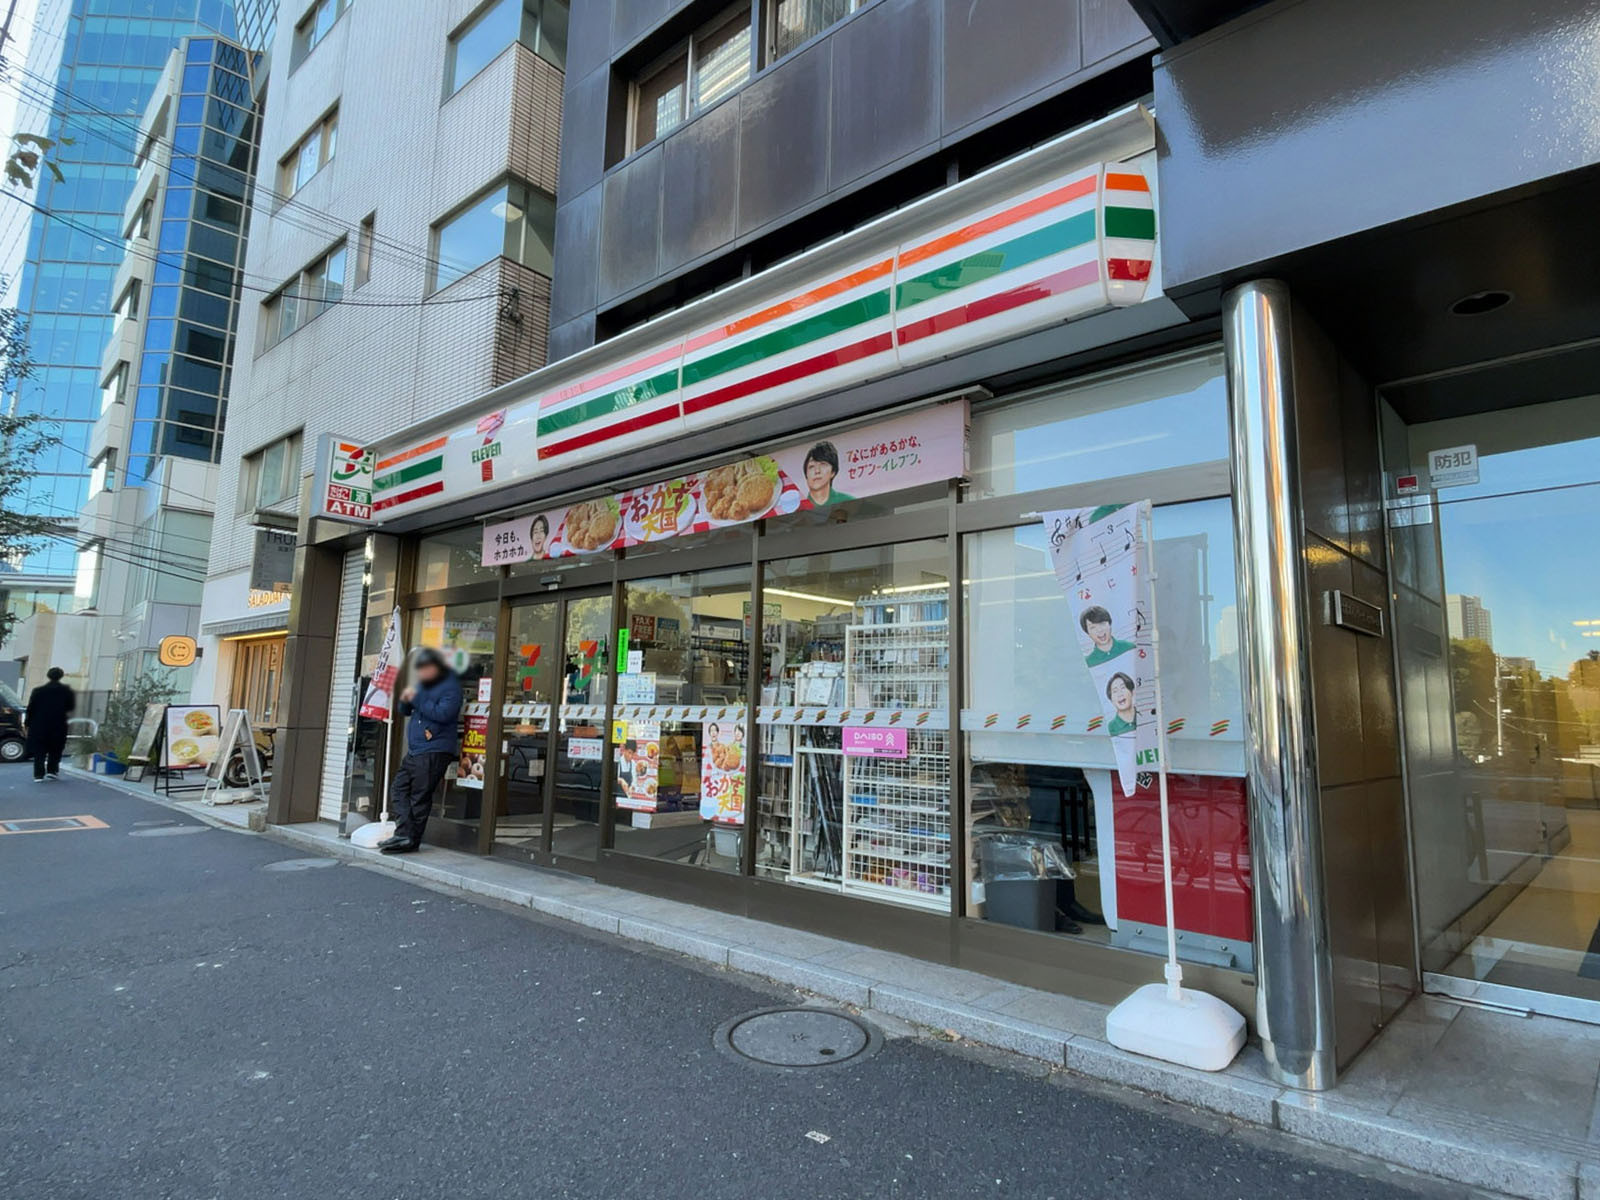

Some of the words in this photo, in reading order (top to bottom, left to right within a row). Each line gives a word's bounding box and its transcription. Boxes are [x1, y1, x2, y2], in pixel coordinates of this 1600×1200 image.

[846, 435, 922, 463] なにがあるかな、
[1434, 451, 1472, 470] 防犯
[329, 486, 350, 500] たばこ
[354, 490, 369, 504] 酒
[630, 479, 699, 523] おかず
[329, 501, 369, 518] ATM
[641, 506, 678, 541] 天国
[494, 530, 520, 546] 今日も、
[494, 544, 528, 561] ホカホカ。
[853, 732, 884, 741] DAISO
[703, 774, 745, 798] おかず
